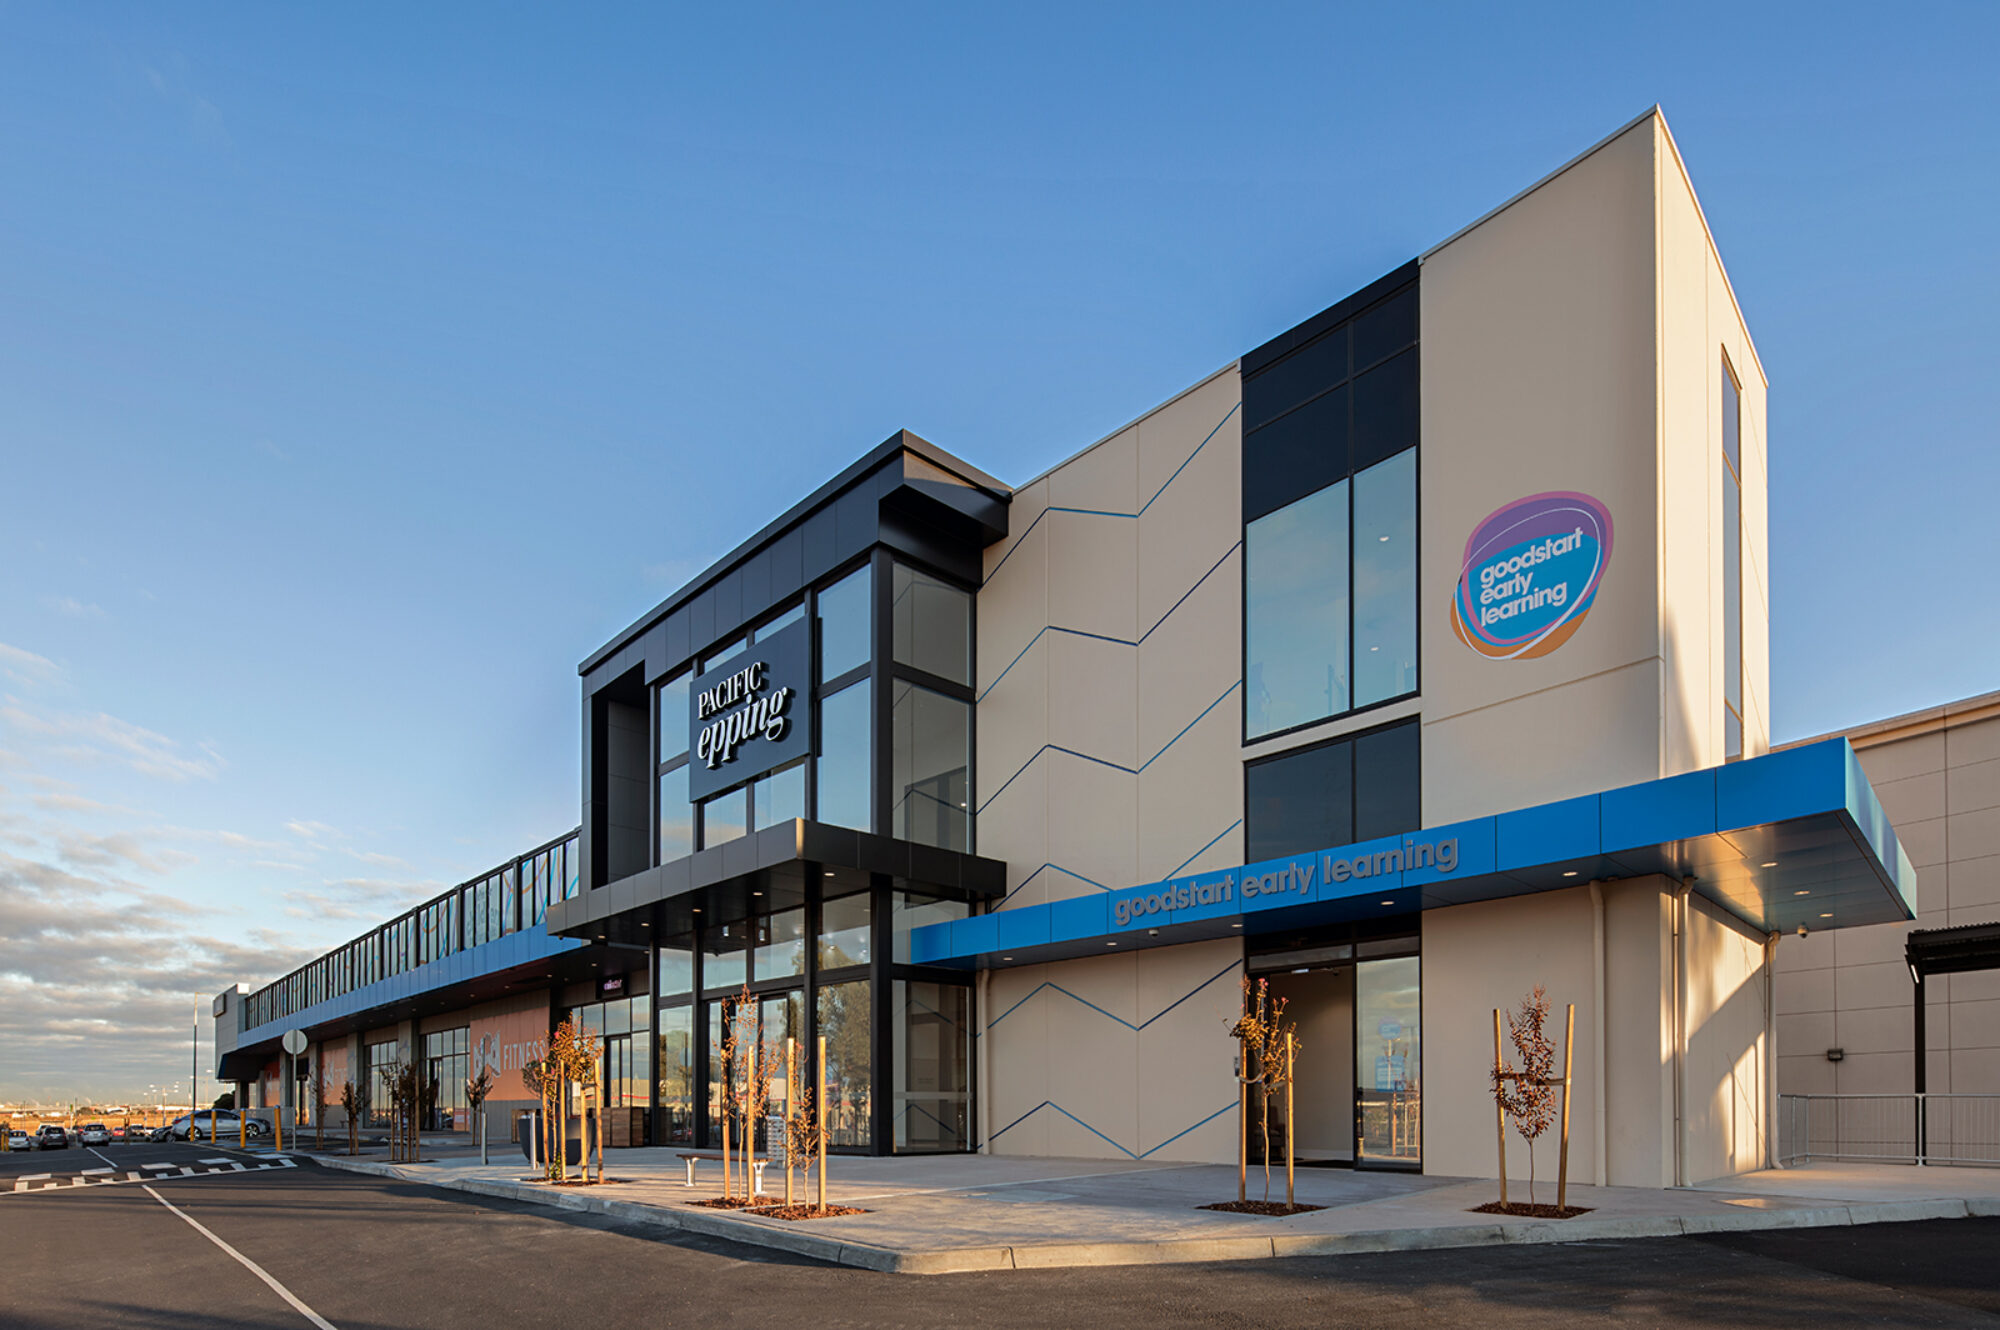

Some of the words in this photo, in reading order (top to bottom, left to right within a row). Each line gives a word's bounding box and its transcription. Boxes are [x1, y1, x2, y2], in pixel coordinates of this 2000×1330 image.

[1480, 527, 1583, 589] goodstart
[1480, 572, 1534, 605] early
[1481, 582, 1567, 627] learning
[698, 661, 761, 720] PACIFIC
[697, 686, 788, 769] epping
[1115, 874, 1234, 926] goodstart
[1241, 862, 1315, 898] early
[1323, 838, 1458, 885] learning
